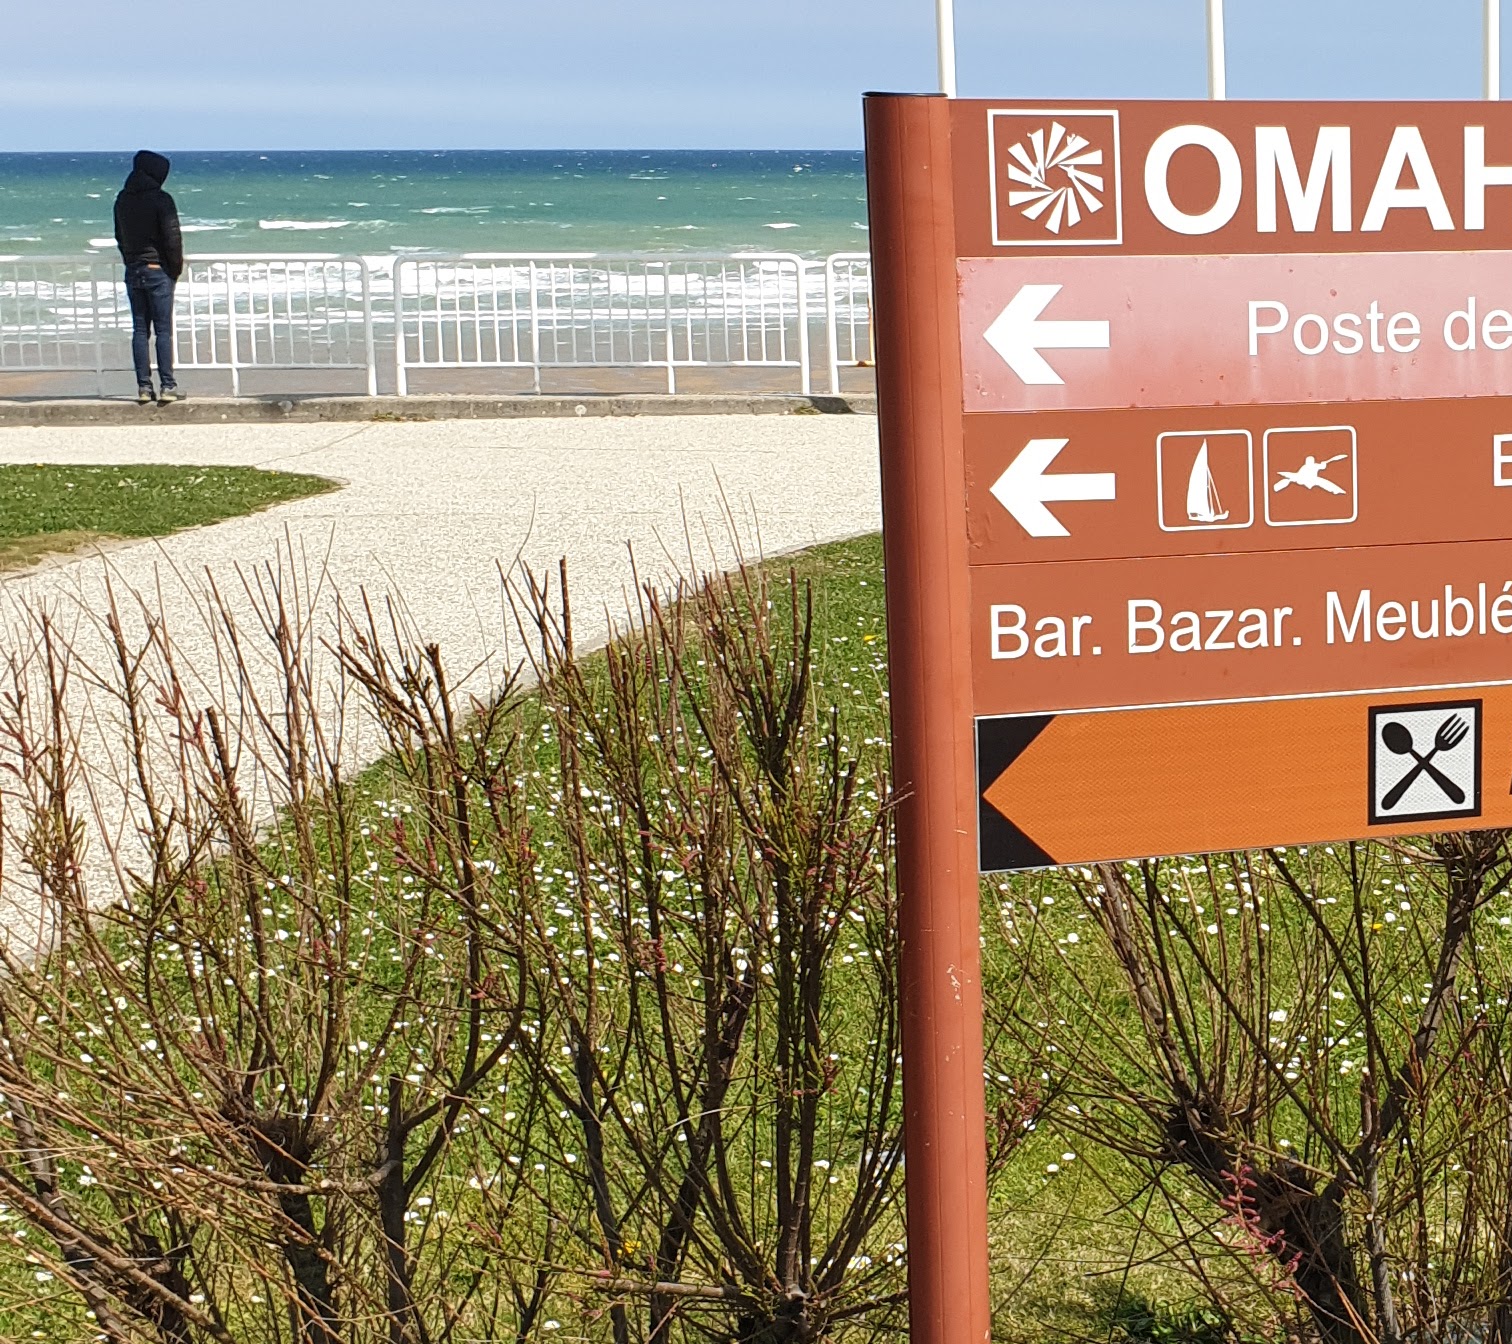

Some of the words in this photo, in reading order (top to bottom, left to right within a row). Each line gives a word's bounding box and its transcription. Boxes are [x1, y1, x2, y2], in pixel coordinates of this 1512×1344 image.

[1245, 295, 1421, 356] Poste
[990, 604, 1102, 660] Bar.
[1127, 599, 1302, 654] Bazar.
